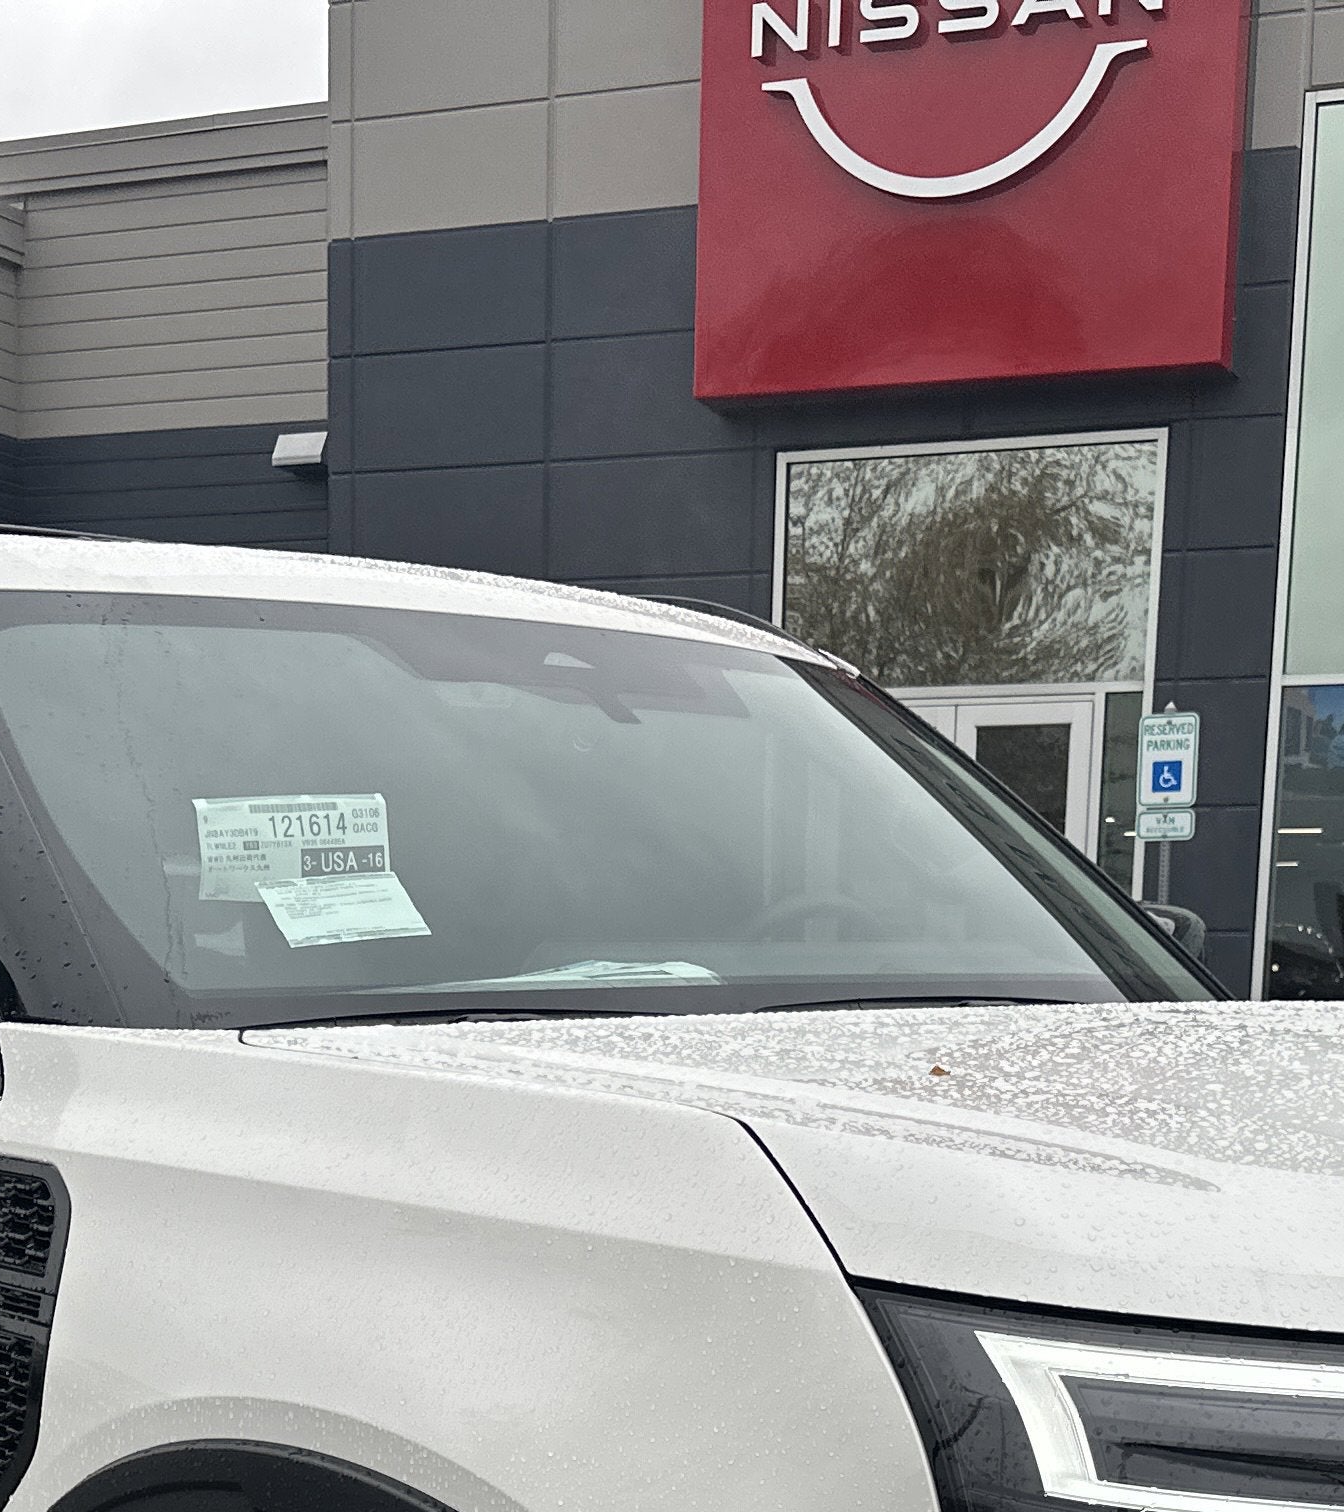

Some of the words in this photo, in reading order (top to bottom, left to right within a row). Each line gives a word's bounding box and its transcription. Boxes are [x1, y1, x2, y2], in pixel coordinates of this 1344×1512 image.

[1143, 723, 1194, 736] RESERVED
[1146, 738, 1191, 751] PARKING
[268, 812, 348, 839] 121614
[321, 851, 358, 872] USA
